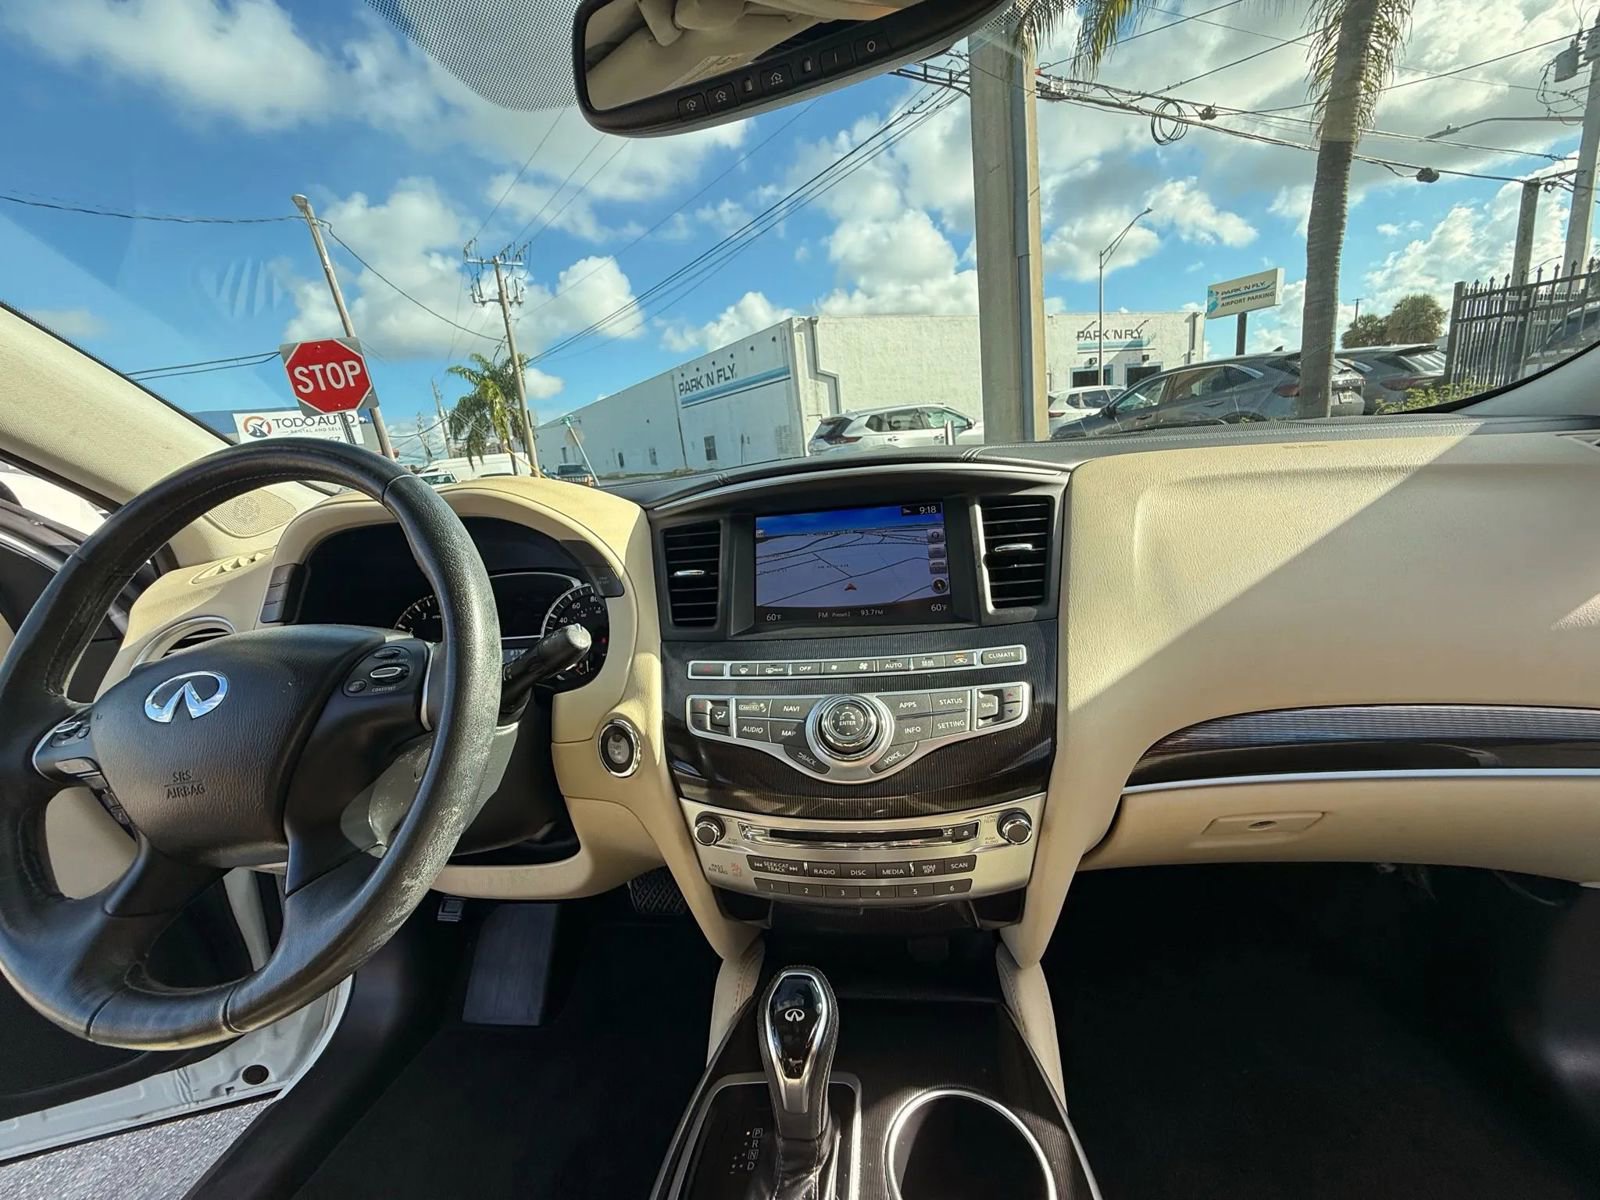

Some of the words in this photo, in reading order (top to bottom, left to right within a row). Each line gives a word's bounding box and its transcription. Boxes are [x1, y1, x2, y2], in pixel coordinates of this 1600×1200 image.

[1220, 297, 1246, 308] AIRPORT
[1247, 290, 1275, 302] PARKING
[1076, 329, 1110, 341] PARK
[1124, 328, 1143, 340] FLY
[293, 360, 361, 394] STOP
[678, 376, 704, 396] PARK
[716, 363, 735, 384] FLY
[272, 416, 316, 429] TODO
[919, 505, 937, 515] 9:18
[571, 602, 581, 610] 60
[818, 610, 828, 619] FM
[988, 651, 1016, 659] CLIMATE
[899, 701, 917, 709] APPS
[939, 697, 963, 706] STATUS
[937, 720, 965, 730] SETTING
[904, 726, 921, 734] INFO
[884, 750, 901, 764] VOICE
[172, 770, 192, 782] SRS
[166, 784, 206, 800] AIRBAG
[950, 862, 969, 870] SCAN
[813, 868, 836, 876] RADIO
[850, 869, 867, 877] DISC
[882, 868, 905, 876] MEDIA
[804, 887, 809, 895] 2
[949, 884, 955, 892] 6
[875, 889, 881, 897] 4
[752, 1140, 759, 1148] R
[747, 1161, 755, 1170] D
